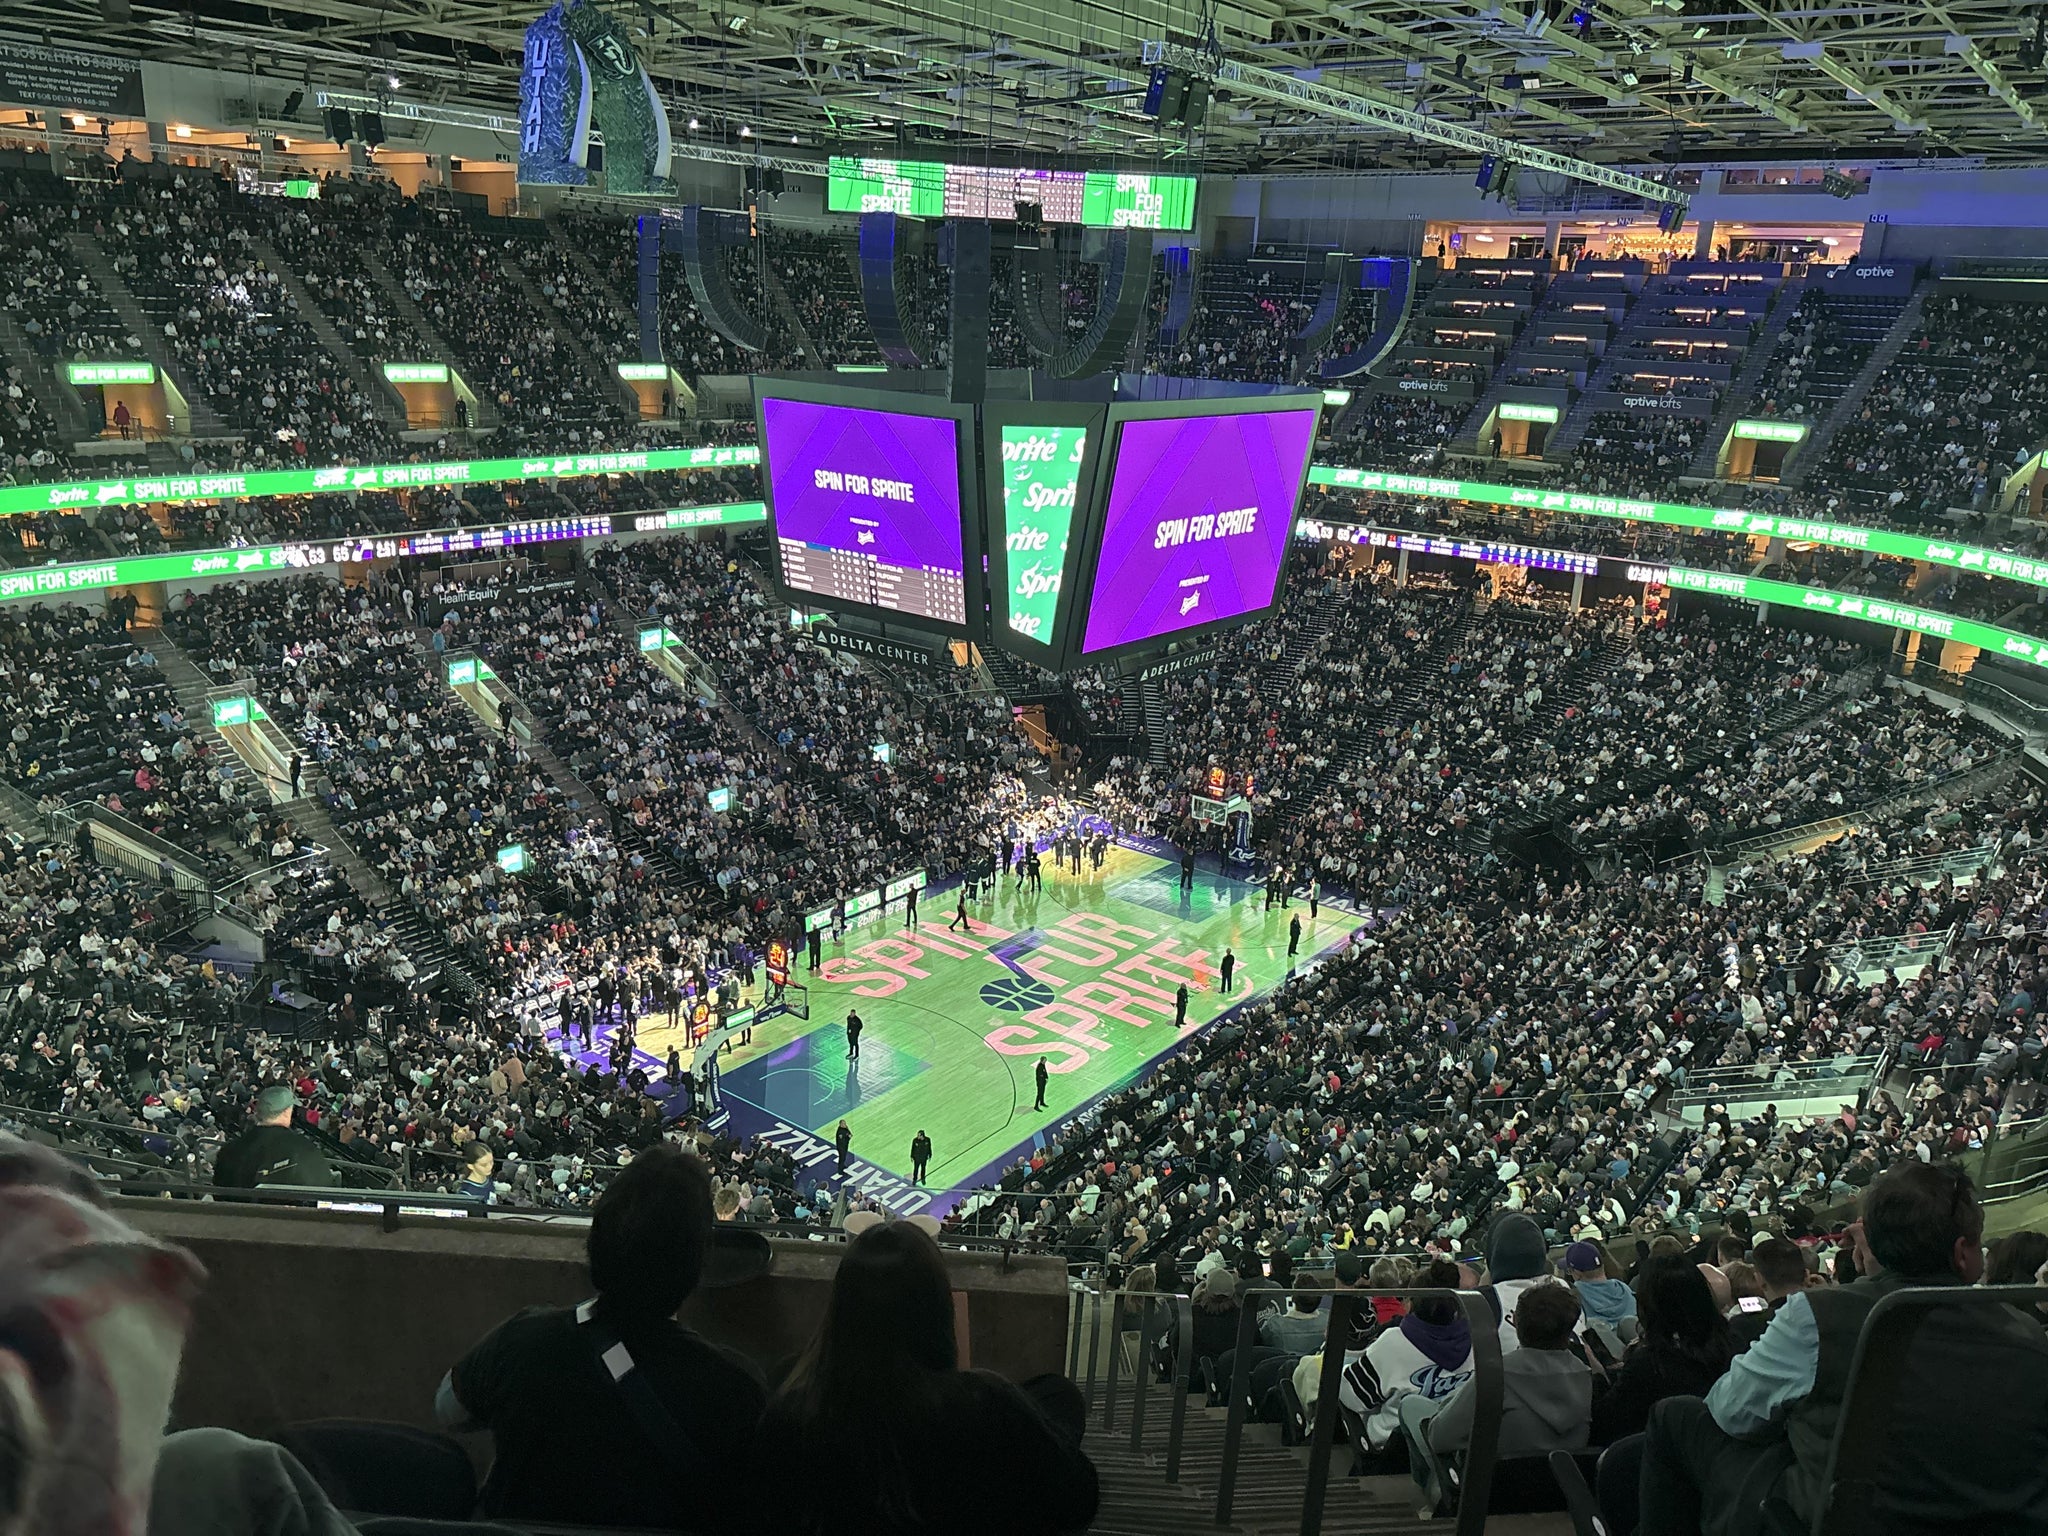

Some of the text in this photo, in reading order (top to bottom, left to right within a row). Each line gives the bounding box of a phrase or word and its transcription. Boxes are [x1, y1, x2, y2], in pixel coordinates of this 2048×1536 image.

[524, 39, 549, 153] UTAH
[1115, 175, 1149, 192] SPIN
[861, 196, 911, 214] SPRITE
[1135, 194, 1164, 211] FOR
[1113, 210, 1161, 228] SPRITE
[1856, 266, 1894, 279] aptive
[1399, 379, 1448, 393] aptive lofts
[1624, 396, 1682, 409] aptive lofts
[577, 455, 647, 471] SPIN FOR SPRITE
[382, 465, 470, 484] SPIN FOR SPRITE
[134, 477, 246, 499] SPIN FOR SPRITE
[814, 469, 915, 503] SPIN FOR SPRITE
[1385, 476, 1461, 496] SPIN FOR SPRITE
[48, 487, 89, 505] Sprite
[679, 511, 695, 525] FOR
[695, 509, 723, 522] SPRITE
[1569, 497, 1655, 518] SPIN FOR SPRITE
[1154, 507, 1258, 549] SPIN FOR SPRITE
[1778, 520, 1869, 546] SPIN FOR SPRITE
[308, 549, 325, 564] 53
[1924, 543, 1957, 560] Sprite
[192, 556, 229, 573] Sprite
[1986, 555, 2012, 574] SPIN
[2011, 560, 2033, 579] FOR
[0, 565, 118, 596] SPIN FOR SPRITE
[1684, 573, 1706, 588] FOR
[1707, 576, 1746, 594] SPRITE
[439, 589, 501, 605] HealthEquity
[1802, 592, 1835, 608] Sprite
[1867, 604, 1953, 636] SPIN FOR SPRITE
[830, 633, 929, 666] DELTA CENTER
[2003, 637, 2034, 656] Sprite
[1150, 649, 1216, 678] DELTA CENTER
[819, 909, 1016, 998] SPIN
[983, 912, 1158, 988] FOR
[984, 937, 1246, 1074] SPRITE
[1410, 1364, 1475, 1399] Jaz
